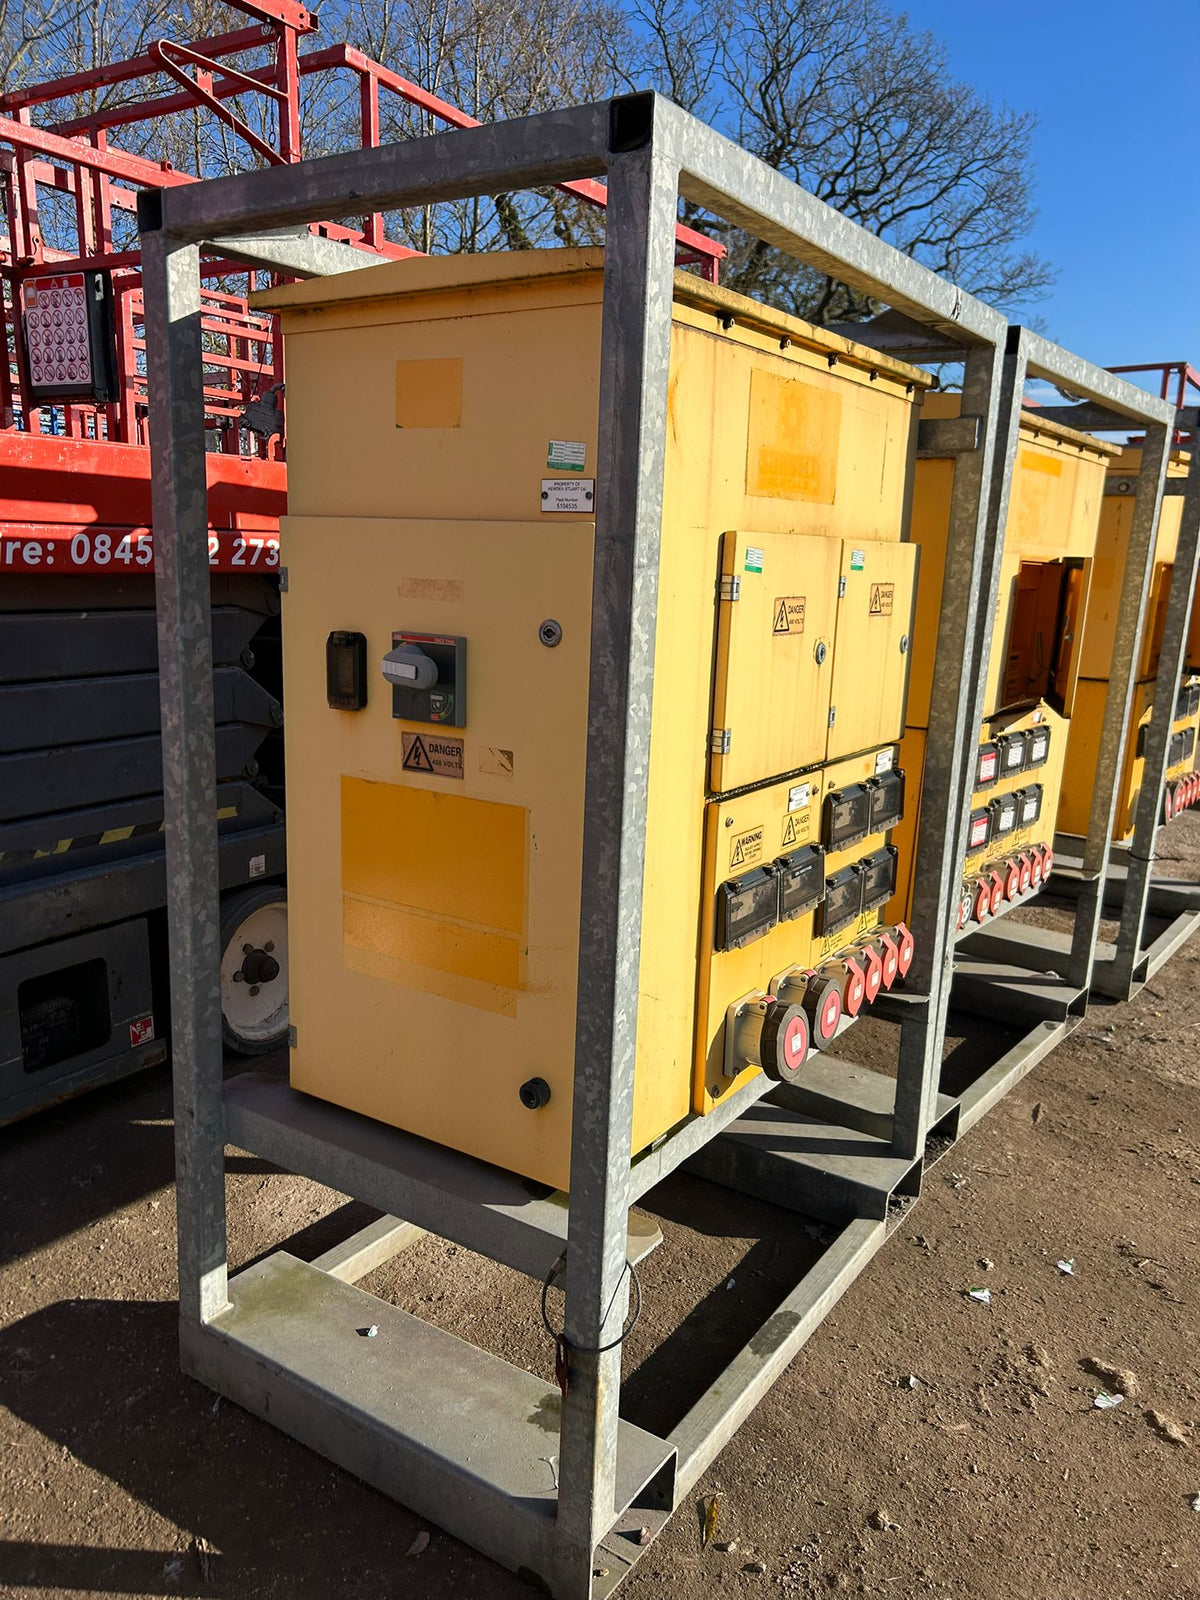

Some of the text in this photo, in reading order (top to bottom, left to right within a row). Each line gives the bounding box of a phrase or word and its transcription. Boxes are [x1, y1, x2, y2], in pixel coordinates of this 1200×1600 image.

[0, 541, 55, 565] re:
[70, 533, 153, 566] 0845
[231, 537, 280, 566] 273
[788, 605, 804, 614] DANGER
[428, 743, 462, 757] DANGER
[794, 814, 810, 827] DANGER
[741, 831, 762, 846] WARNING
